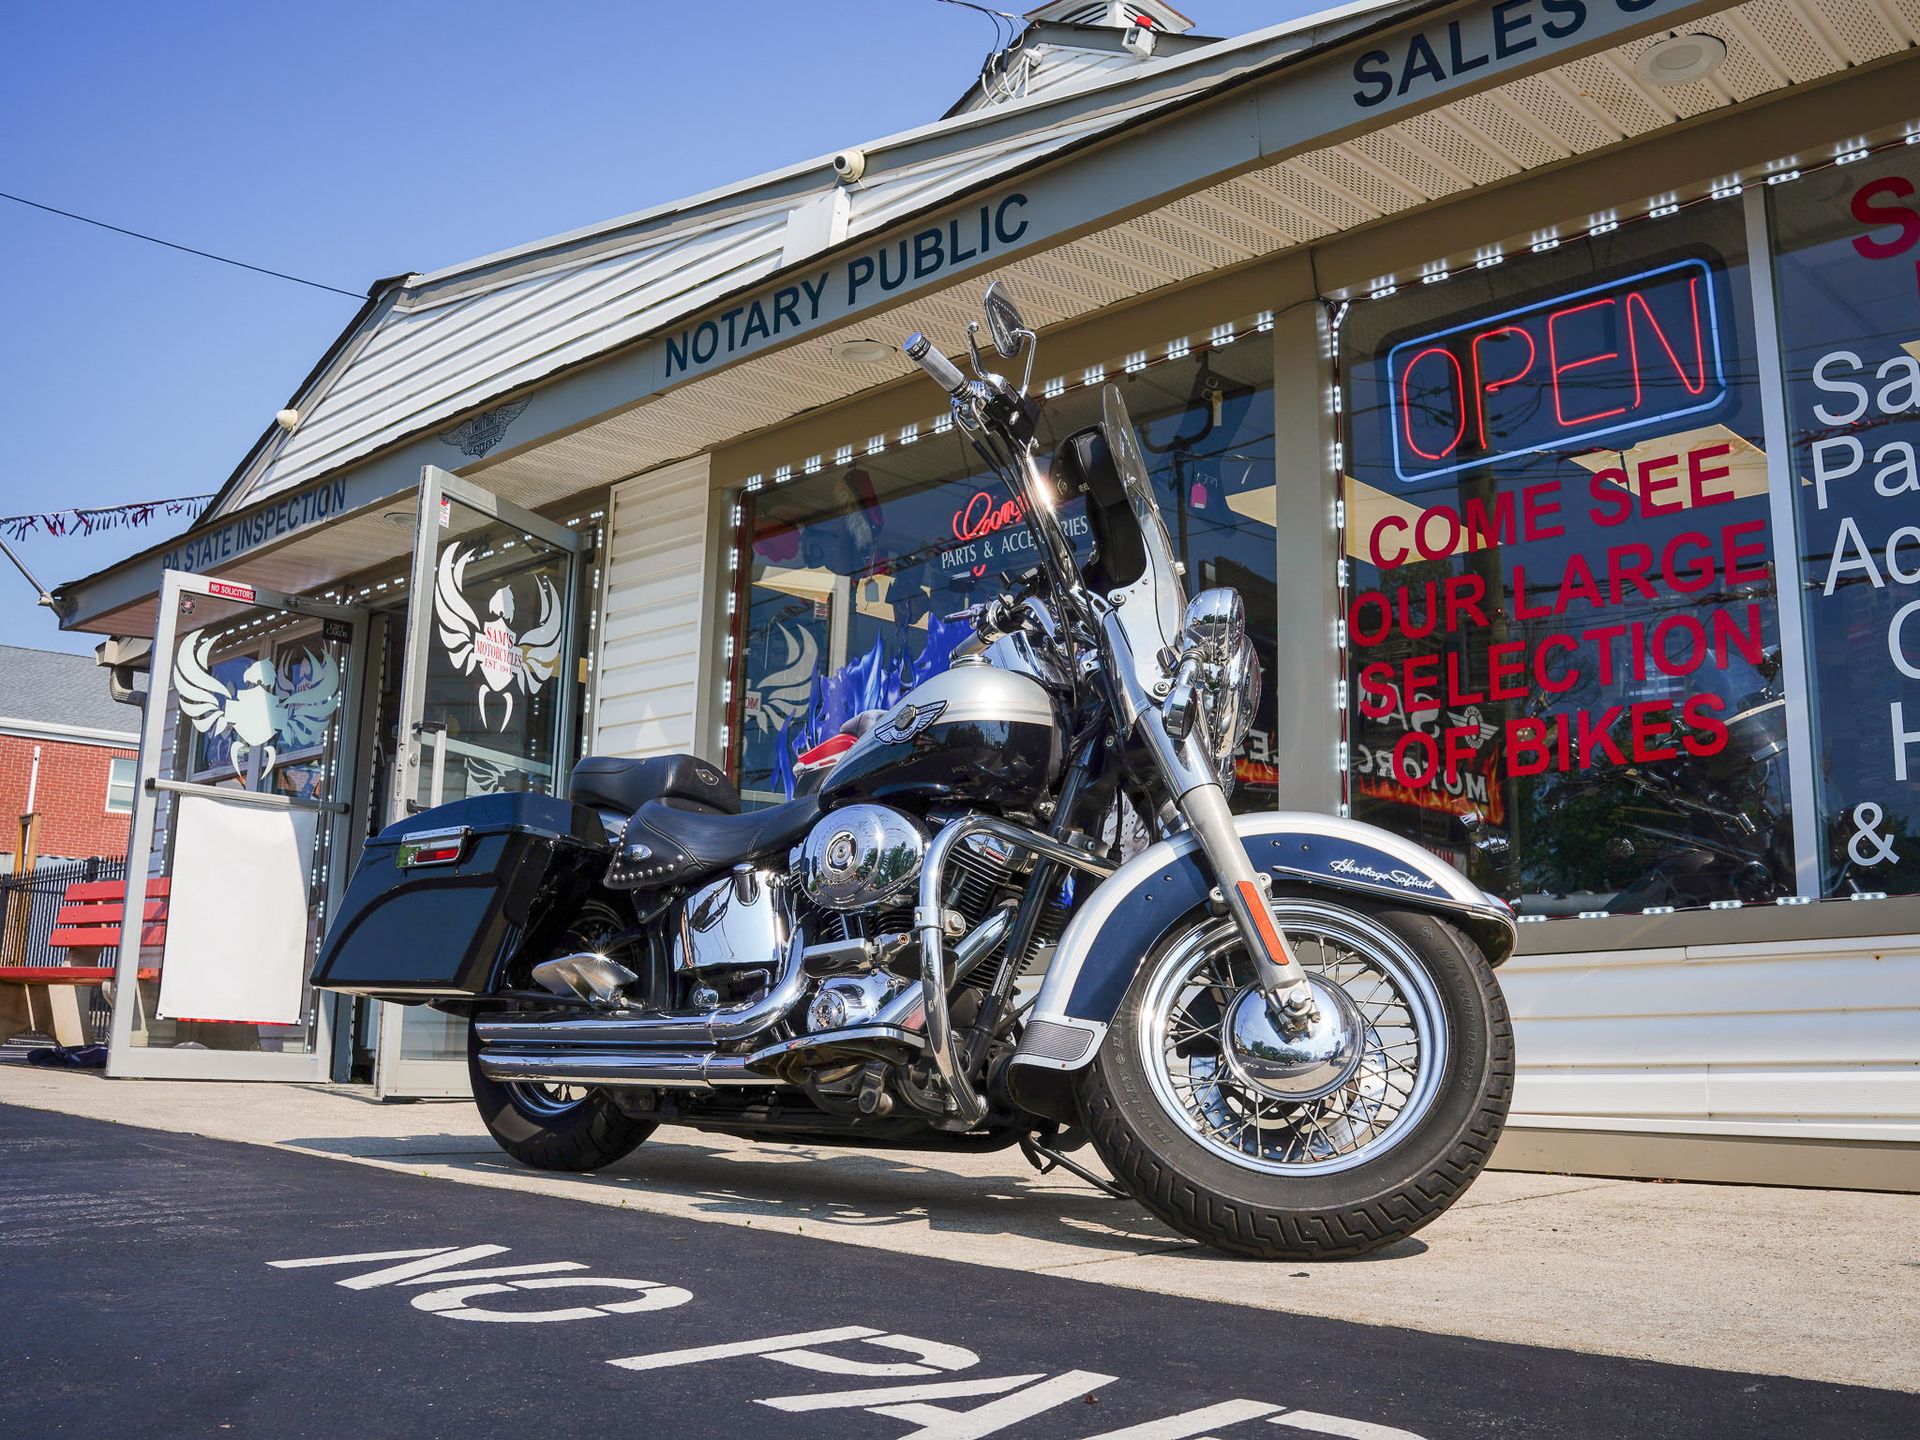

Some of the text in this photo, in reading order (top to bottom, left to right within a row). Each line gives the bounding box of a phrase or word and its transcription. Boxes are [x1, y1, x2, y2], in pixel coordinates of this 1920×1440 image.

[1352, 0, 1587, 108] SALES
[665, 193, 1029, 378] NOTARY PUBLIC
[1403, 278, 1705, 460] OPEN
[1812, 350, 1920, 426] Sa
[1368, 444, 1736, 570] COME SEE
[1812, 435, 1920, 510] Pa
[184, 527, 232, 572] STATE
[236, 478, 347, 551] INSPECTION
[941, 545, 977, 569] PARTS
[984, 540, 994, 559] &
[1001, 515, 1089, 555] ACCERIES
[210, 583, 254, 600] NO SOLICITORS
[1347, 519, 1769, 647] OUR LARGE
[476, 640, 522, 668] MOTORCYCLES
[486, 626, 514, 650] SAM'S
[1359, 603, 1764, 718] SELECTION
[1391, 692, 1729, 788] OF BIKES
[1329, 858, 1390, 882] Heritage
[1847, 801, 1900, 867] &
[265, 1243, 695, 1324] NO
